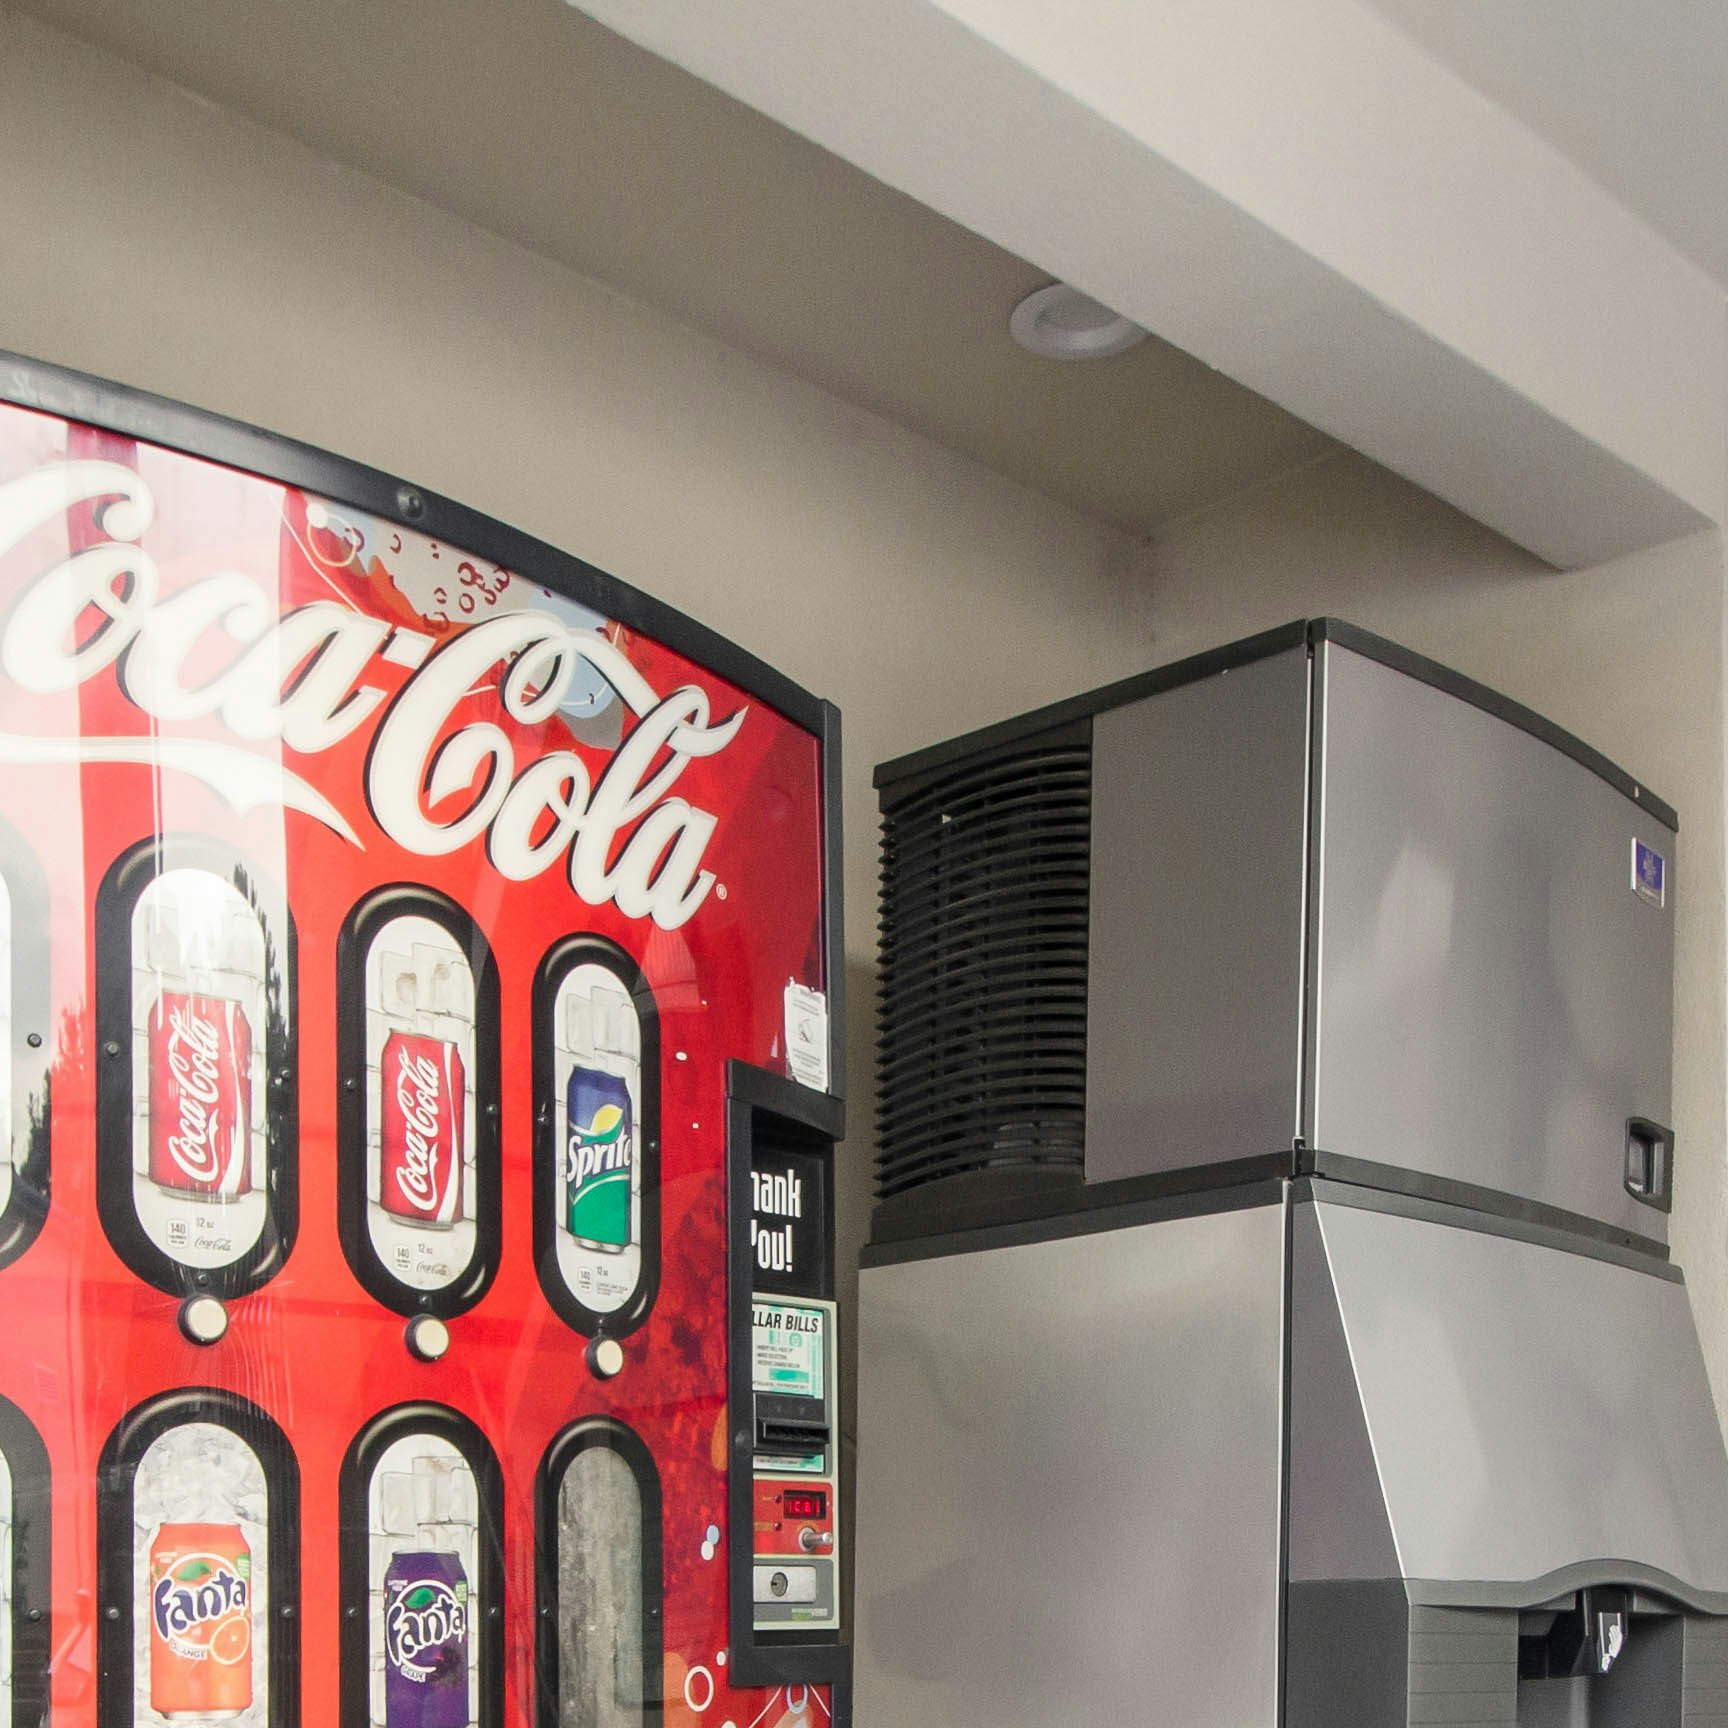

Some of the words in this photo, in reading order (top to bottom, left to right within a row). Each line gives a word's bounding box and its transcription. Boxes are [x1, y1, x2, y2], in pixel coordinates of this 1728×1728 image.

[167, 1001, 221, 1183] Coca-Cola
[395, 1044, 440, 1211] Coca-Cola
[567, 1124, 631, 1189] Sprite
[170, 1223, 186, 1234] 140
[397, 1248, 410, 1259] 140
[752, 1310, 782, 1329] LLAR
[785, 1314, 819, 1333] BILLS
